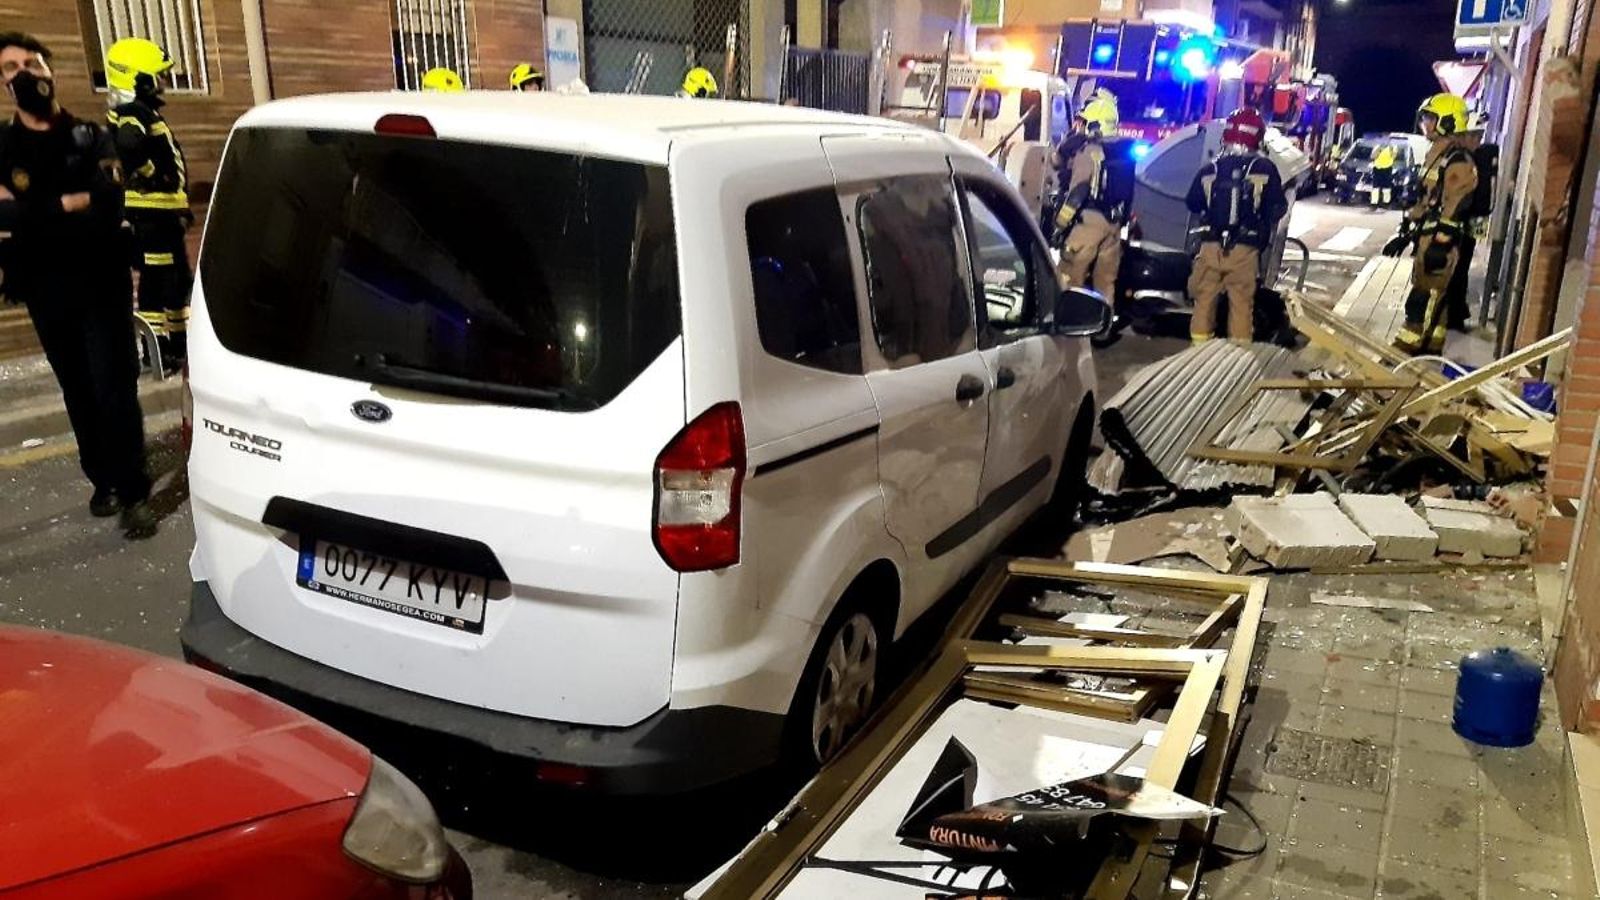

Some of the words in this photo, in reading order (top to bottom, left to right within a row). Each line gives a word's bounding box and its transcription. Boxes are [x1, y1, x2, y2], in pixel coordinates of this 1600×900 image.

[356, 402, 386, 420] Ford
[203, 418, 282, 450] TOURNEO
[230, 441, 282, 462] COURIER
[324, 545, 398, 591] 0077
[407, 564, 472, 610] KYV
